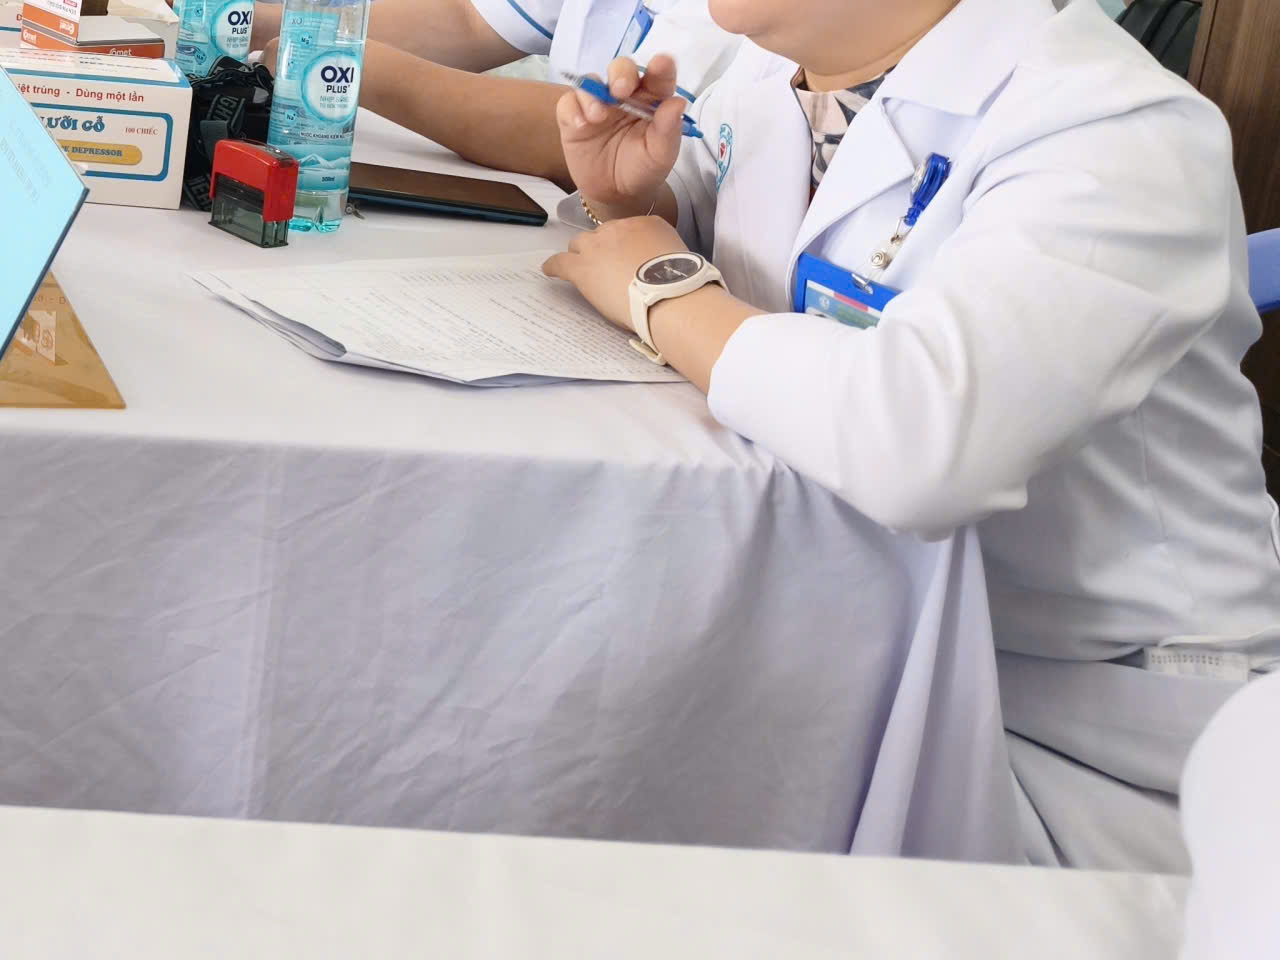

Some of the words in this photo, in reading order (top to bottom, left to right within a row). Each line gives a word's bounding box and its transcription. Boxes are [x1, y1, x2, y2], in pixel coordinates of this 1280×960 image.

[228, 10, 253, 26] OXI
[231, 26, 248, 35] PLUS
[320, 65, 355, 84] OXI
[75, 88, 103, 101] Dùng
[106, 91, 126, 103] một
[128, 90, 145, 102] lần
[326, 84, 348, 94] PLUS
[81, 115, 105, 133] GỖ
[71, 145, 123, 158] DEPRESSOR
